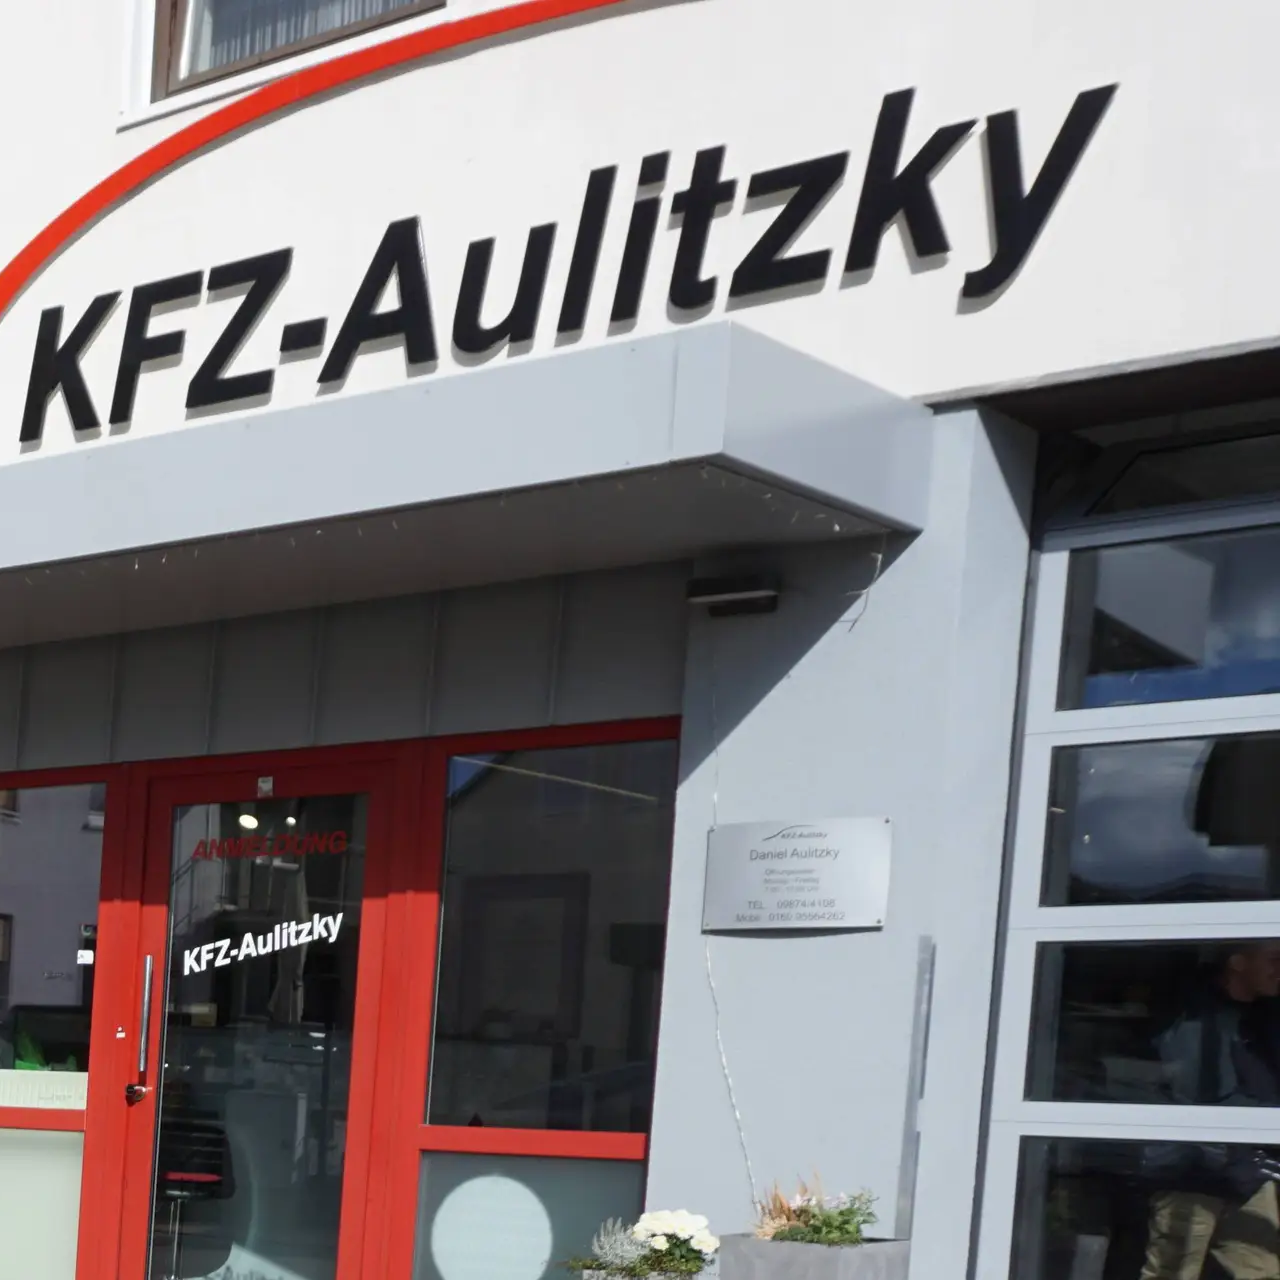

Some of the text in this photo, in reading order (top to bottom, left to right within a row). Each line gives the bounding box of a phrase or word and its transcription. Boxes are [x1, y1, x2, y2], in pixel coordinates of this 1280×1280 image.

[20, 84, 1119, 443] KFZ-Aulitzky
[192, 830, 347, 860] ANMELDUNG
[749, 847, 840, 861] Daniel Aulitzky
[183, 912, 344, 976] KFZ-Aulitzky
